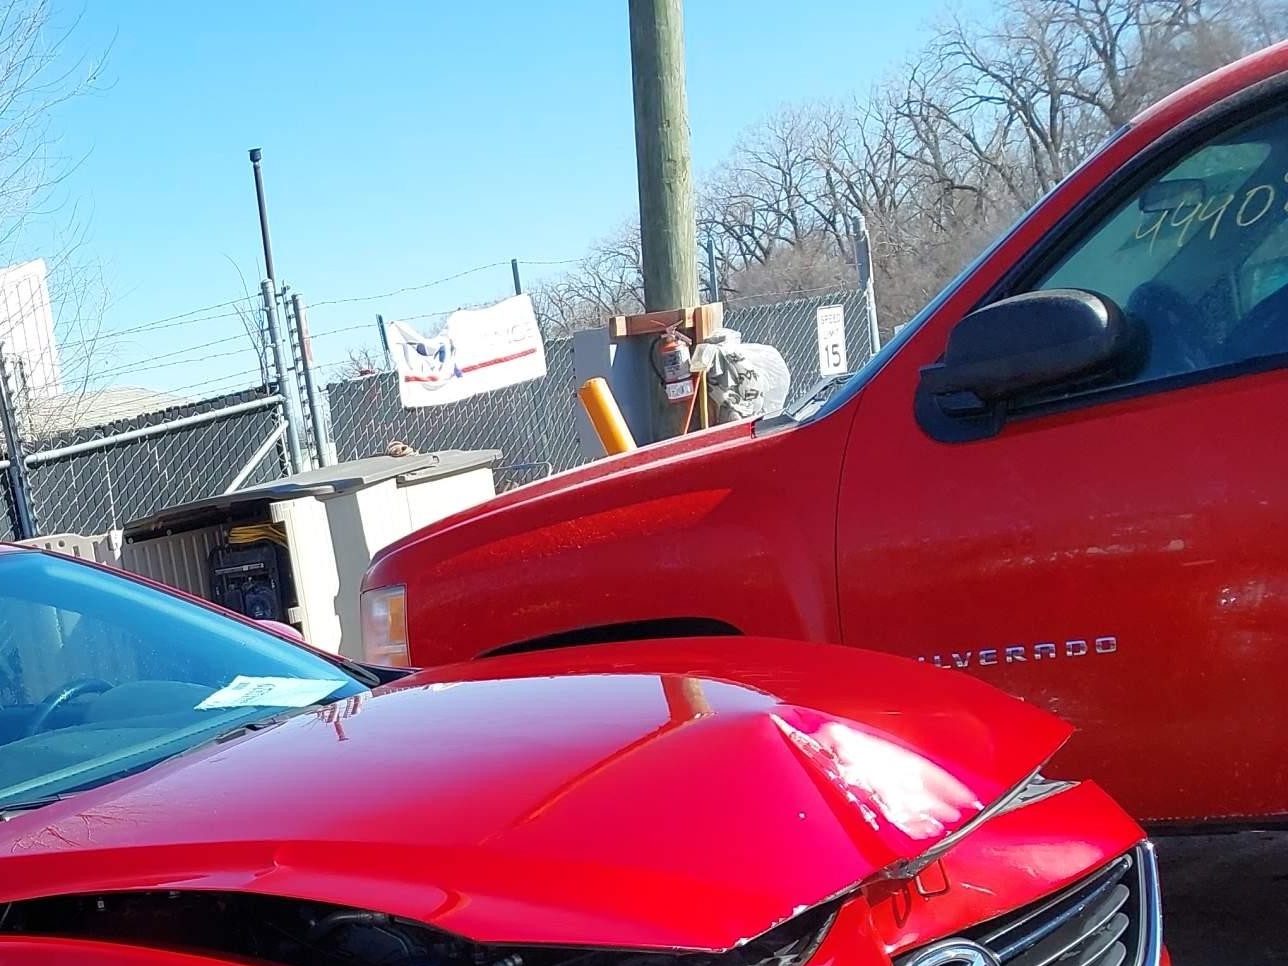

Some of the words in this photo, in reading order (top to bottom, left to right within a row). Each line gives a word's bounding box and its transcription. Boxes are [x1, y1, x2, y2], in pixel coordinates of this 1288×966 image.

[1135, 174, 1288, 256] 4440
[824, 343, 842, 368] 15
[918, 636, 1117, 668] LVERADO
